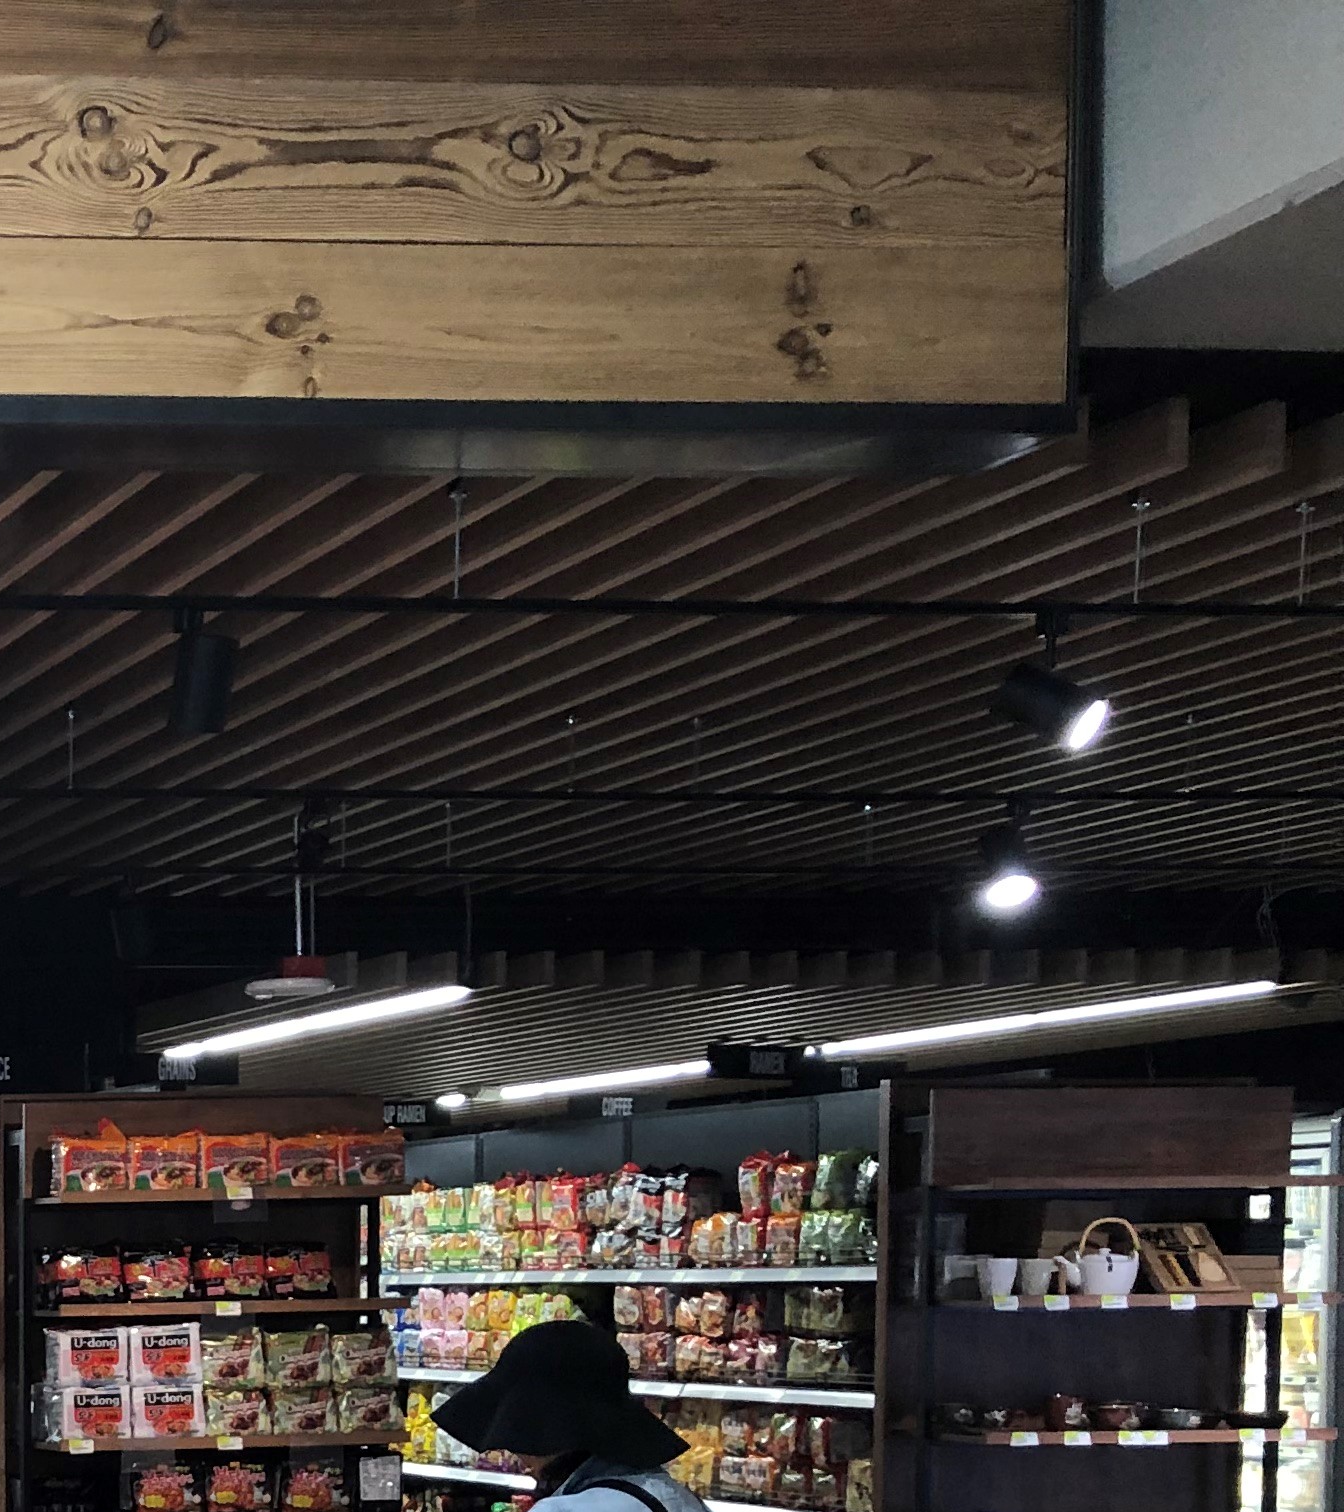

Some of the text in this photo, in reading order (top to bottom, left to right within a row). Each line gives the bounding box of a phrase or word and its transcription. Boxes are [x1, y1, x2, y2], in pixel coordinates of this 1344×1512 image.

[158, 1057, 196, 1080] GRAINS
[602, 1097, 633, 1116] COFFEE
[383, 1104, 426, 1124] UP RAMEN
[74, 1337, 117, 1349] U-dong
[145, 1336, 189, 1348] U-dong
[76, 1395, 120, 1407] U-dong
[147, 1393, 192, 1406] U-dong
